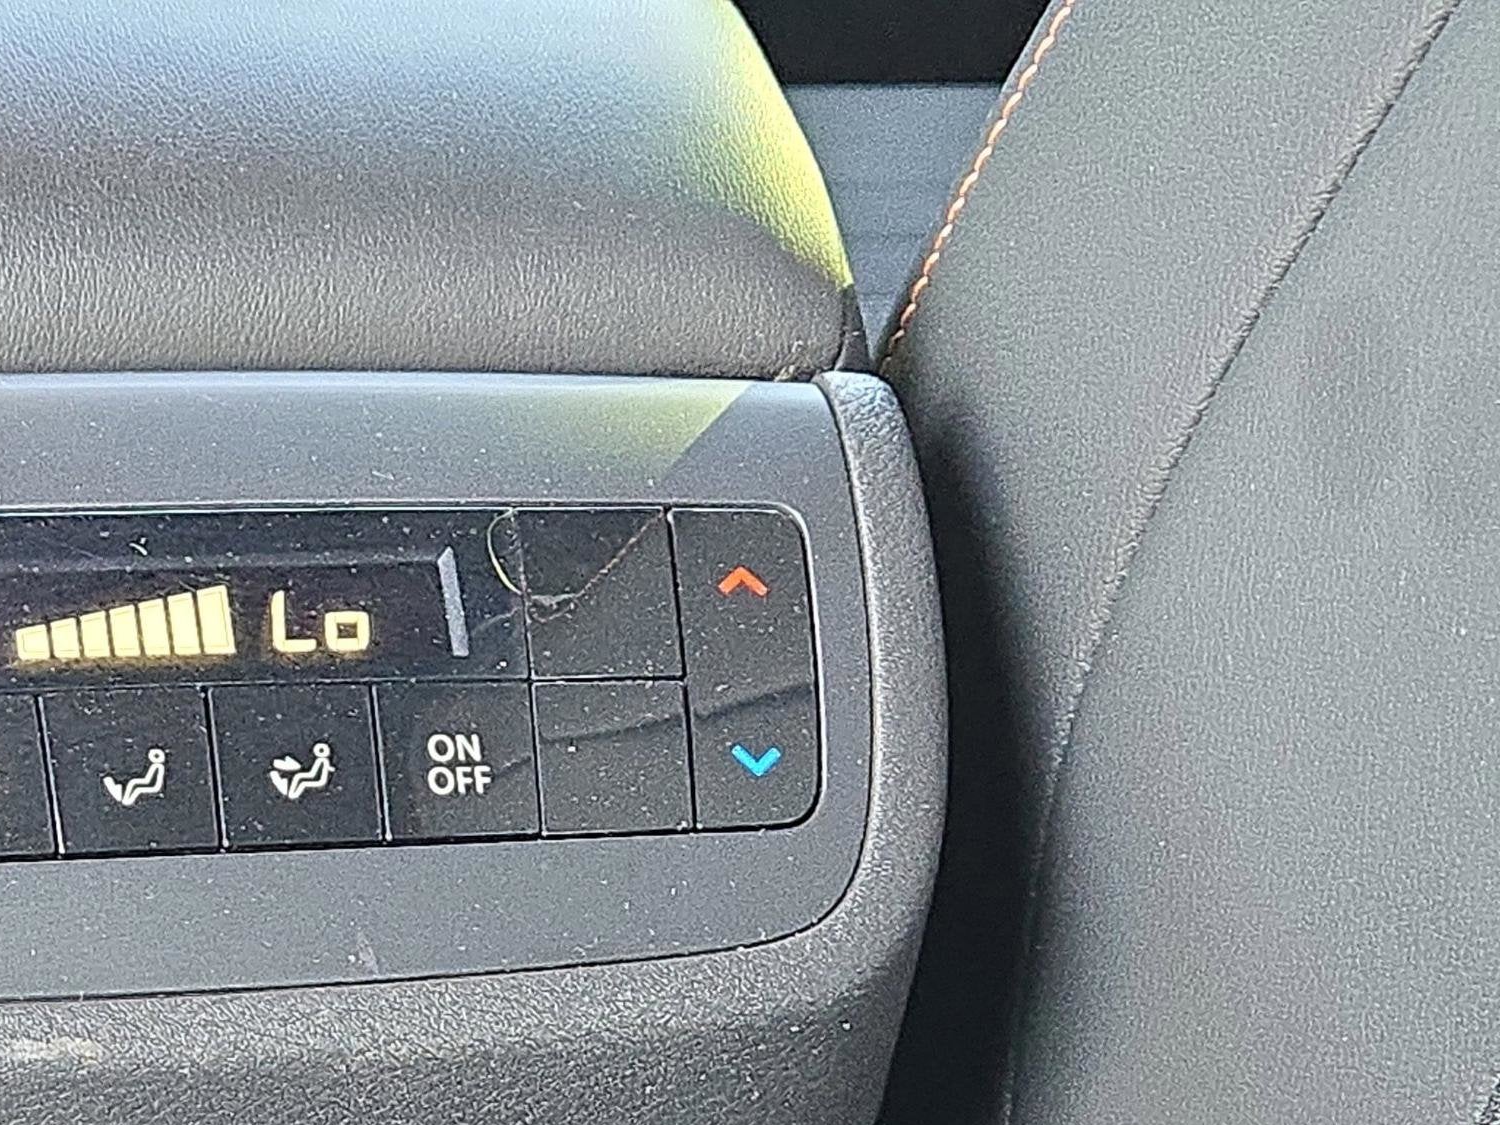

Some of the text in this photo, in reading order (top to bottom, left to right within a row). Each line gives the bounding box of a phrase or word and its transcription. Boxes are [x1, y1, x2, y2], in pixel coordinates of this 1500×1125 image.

[270, 588, 371, 654] Lo
[427, 733, 483, 764] ON
[427, 764, 491, 796] OFF
